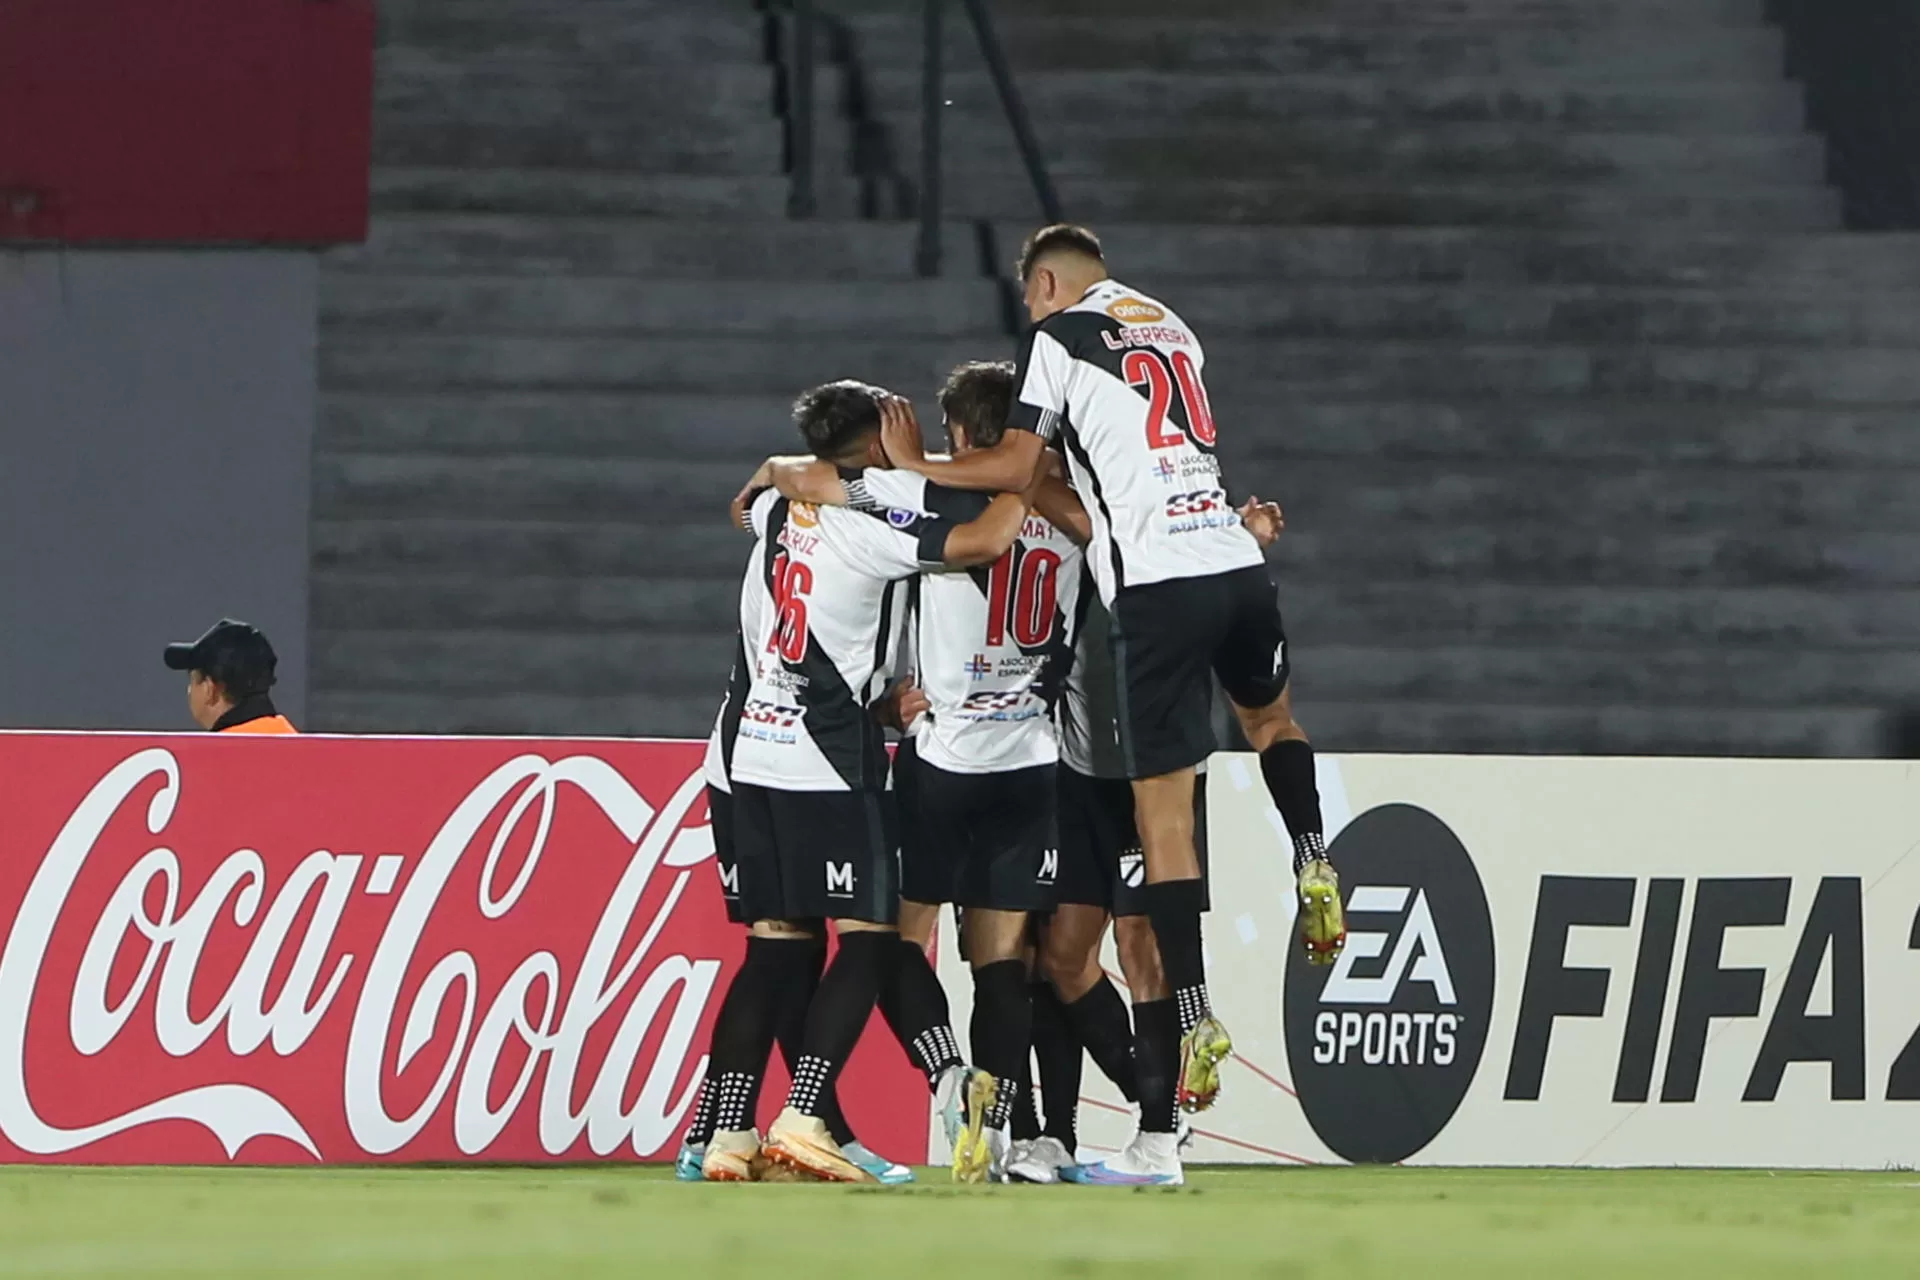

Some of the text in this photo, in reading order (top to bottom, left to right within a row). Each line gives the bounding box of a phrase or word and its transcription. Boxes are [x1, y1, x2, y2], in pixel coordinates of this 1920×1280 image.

[1122, 350, 1216, 450] 20
[766, 552, 815, 663] 16
[986, 545, 1062, 648] 10
[826, 861, 853, 892] M
[0, 748, 721, 1160] Coca-Cola
[1319, 886, 1457, 1004] EA
[1313, 1011, 1458, 1065] SPORTS
